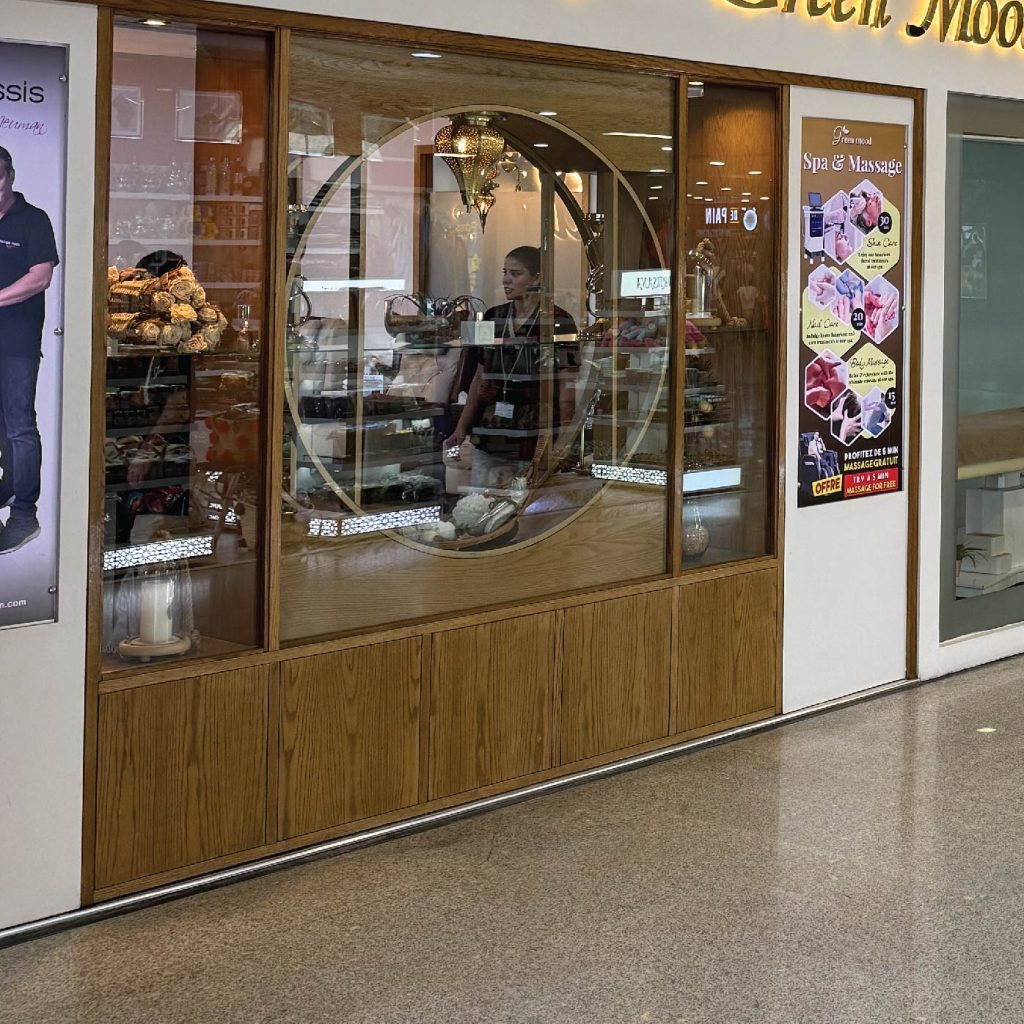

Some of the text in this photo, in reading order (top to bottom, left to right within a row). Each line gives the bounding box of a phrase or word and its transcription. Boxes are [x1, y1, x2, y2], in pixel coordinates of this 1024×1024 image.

[803, 151, 903, 178] Spa & Massage
[880, 216, 890, 227] 30
[853, 312, 863, 321] 20
[844, 448, 874, 461] PROFITEZ
[844, 456, 898, 471] MASSAGE GRATUIT
[815, 477, 841, 494] OFFRE
[853, 475, 865, 484] TRY
[847, 480, 896, 494] MASSAGE FOR FREE
